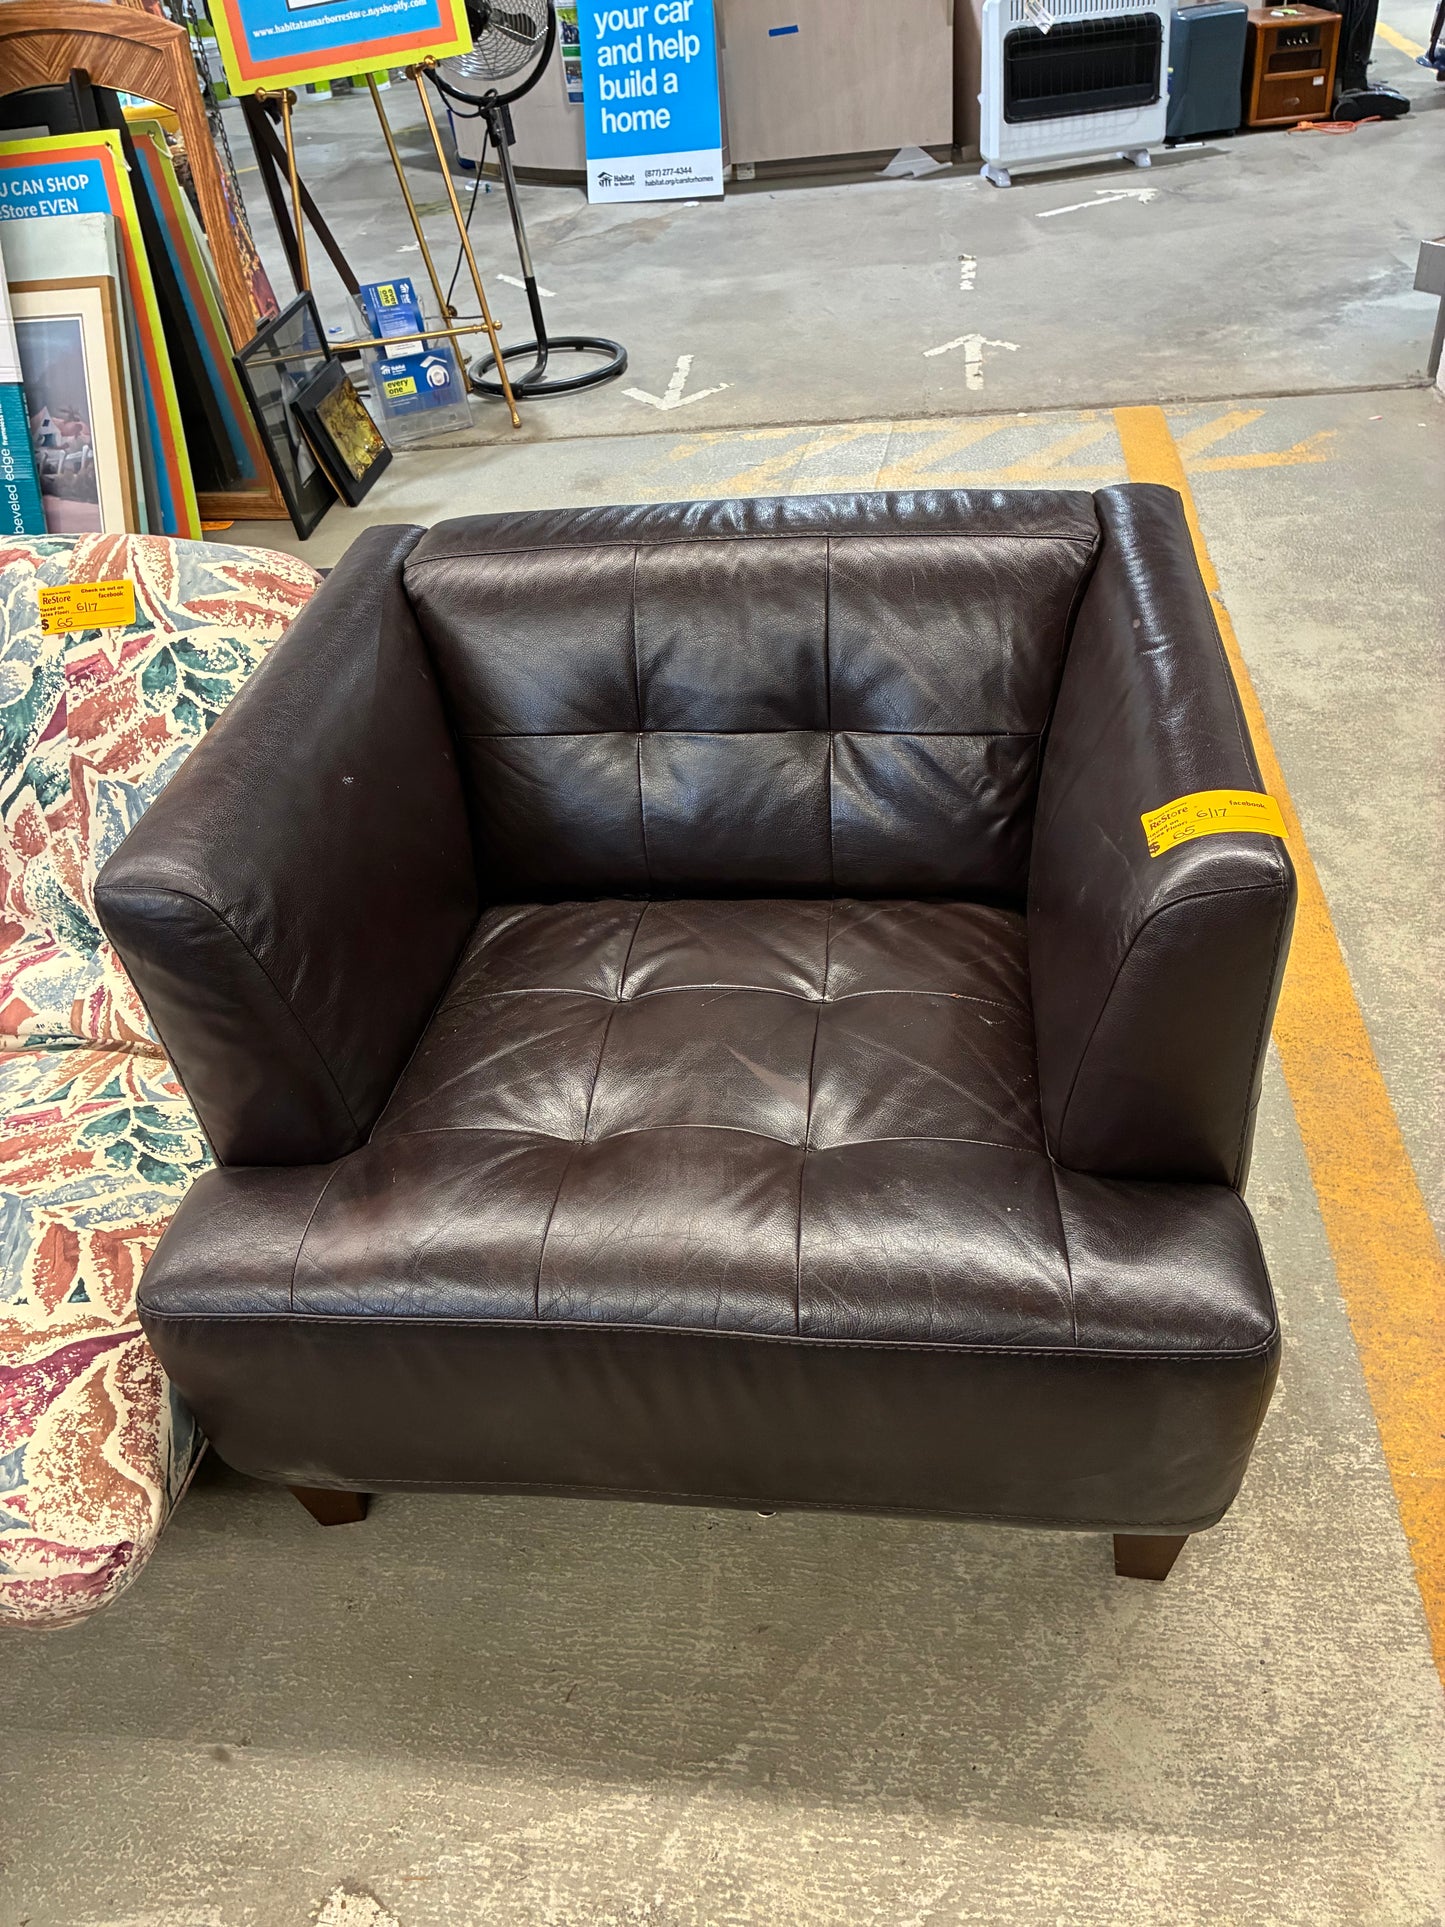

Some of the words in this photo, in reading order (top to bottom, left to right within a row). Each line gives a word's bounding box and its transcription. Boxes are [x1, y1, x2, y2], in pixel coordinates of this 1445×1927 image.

[252, 0, 428, 38] www.habitatannarborrestore.myshopify.com
[593, 6, 649, 39] your
[654, 0, 694, 25] car
[597, 35, 643, 67] and
[648, 29, 700, 63] help
[599, 68, 657, 101] build
[663, 71, 679, 94] a
[601, 107, 671, 134] home
[645, 168, 661, 178] (877)
[662, 166, 692, 177] 277-4344
[11, 178, 45, 196] CAN
[46, 174, 89, 193] SHOP
[39, 197, 79, 216] EVEN
[387, 379, 408, 388] every
[389, 386, 404, 394] one
[2, 448, 15, 481] edge
[5, 484, 25, 535] beveled
[42, 595, 71, 605] ReStore
[76, 602, 98, 612] 6/17
[41, 618, 49, 631] $
[57, 617, 73, 628] 65
[1196, 808, 1227, 818] 6/17
[1229, 800, 1265, 808] facebook
[1150, 807, 1188, 831] ReStore
[1149, 841, 1160, 854] $
